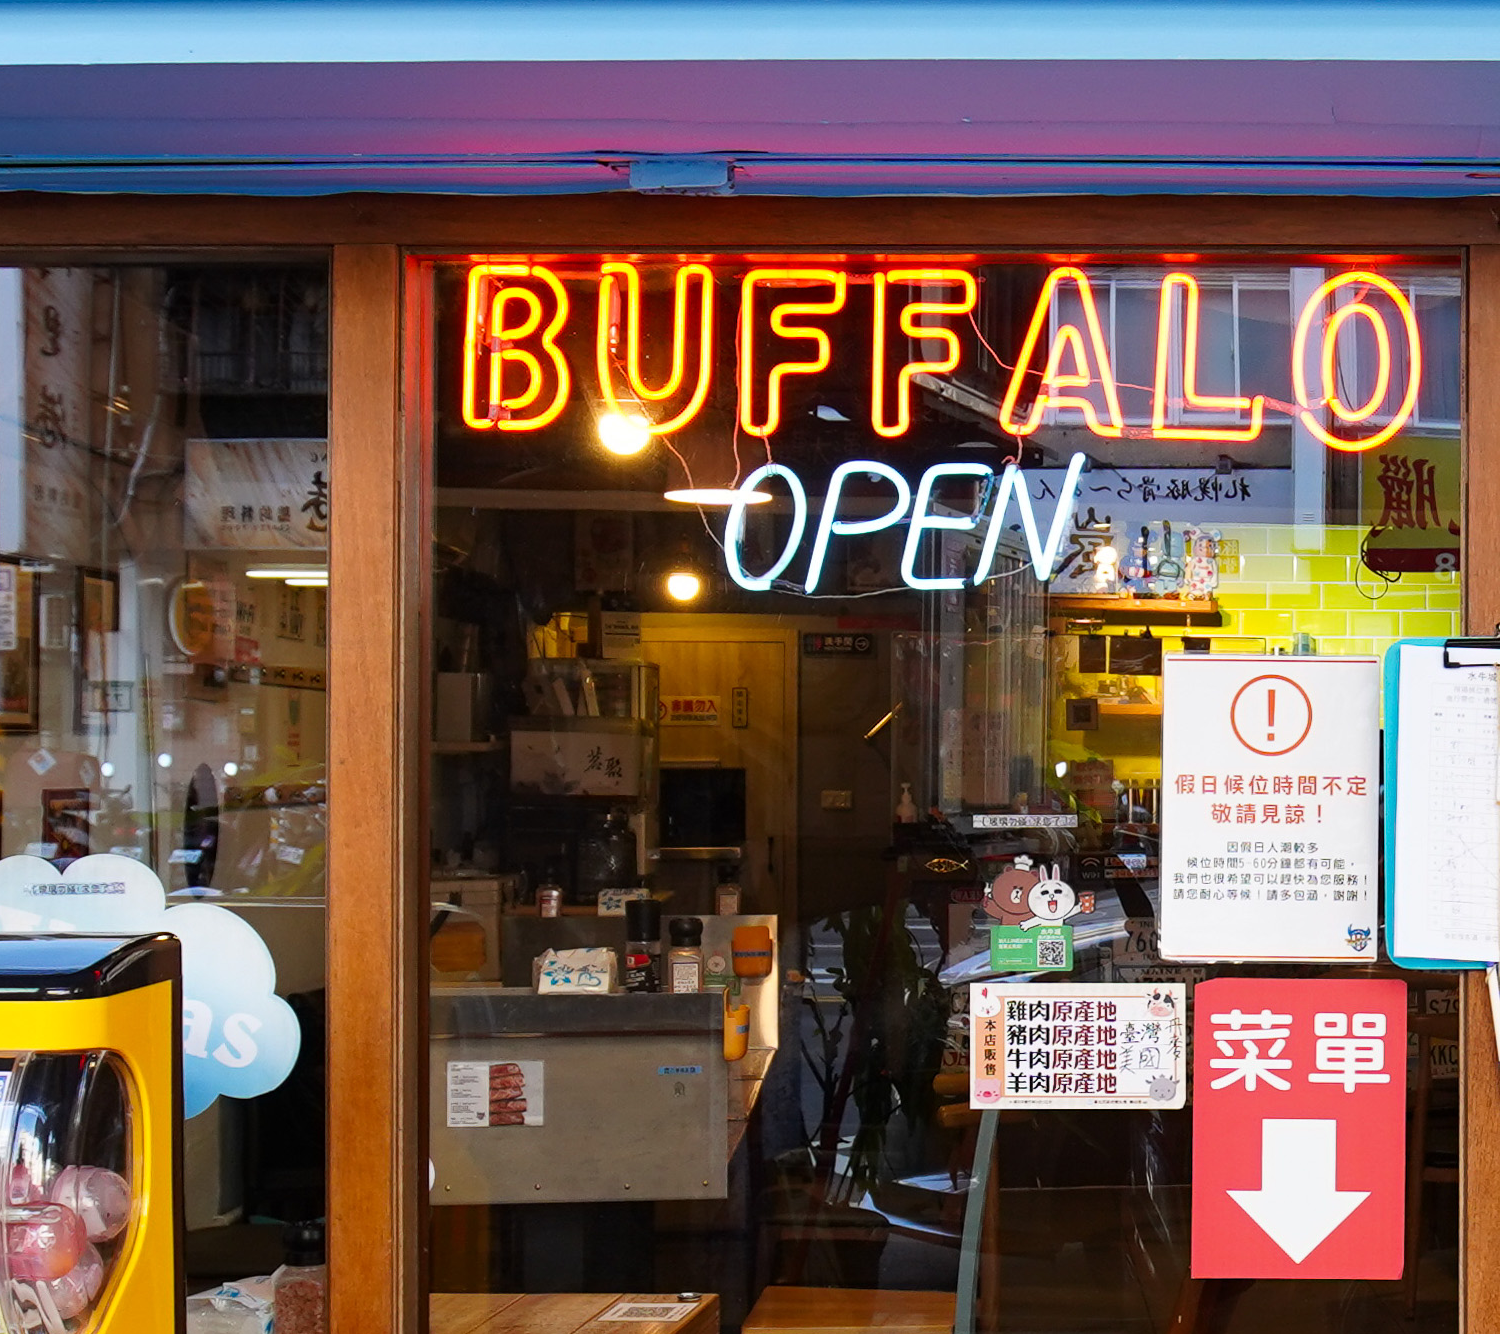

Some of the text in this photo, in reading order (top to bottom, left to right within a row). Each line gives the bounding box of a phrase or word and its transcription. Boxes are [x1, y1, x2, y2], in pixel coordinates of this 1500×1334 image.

[458, 259, 1426, 453] BUFFALO
[722, 450, 1088, 591] OPEN
[1174, 774, 1368, 796] 假日候位時間不定
[1211, 803, 1322, 825] 敬請見諒！
[1226, 841, 1320, 854] 因假日人潮較多
[1006, 999, 1117, 1022] 雞肉原產地
[1006, 1024, 1117, 1046] 豬肉原產地
[983, 1019, 998, 1077] 本店販售
[1006, 1048, 1117, 1070] 牛肉原產地
[1208, 1007, 1390, 1094] 菜單
[1006, 1072, 1117, 1094] 羊肉原產地
